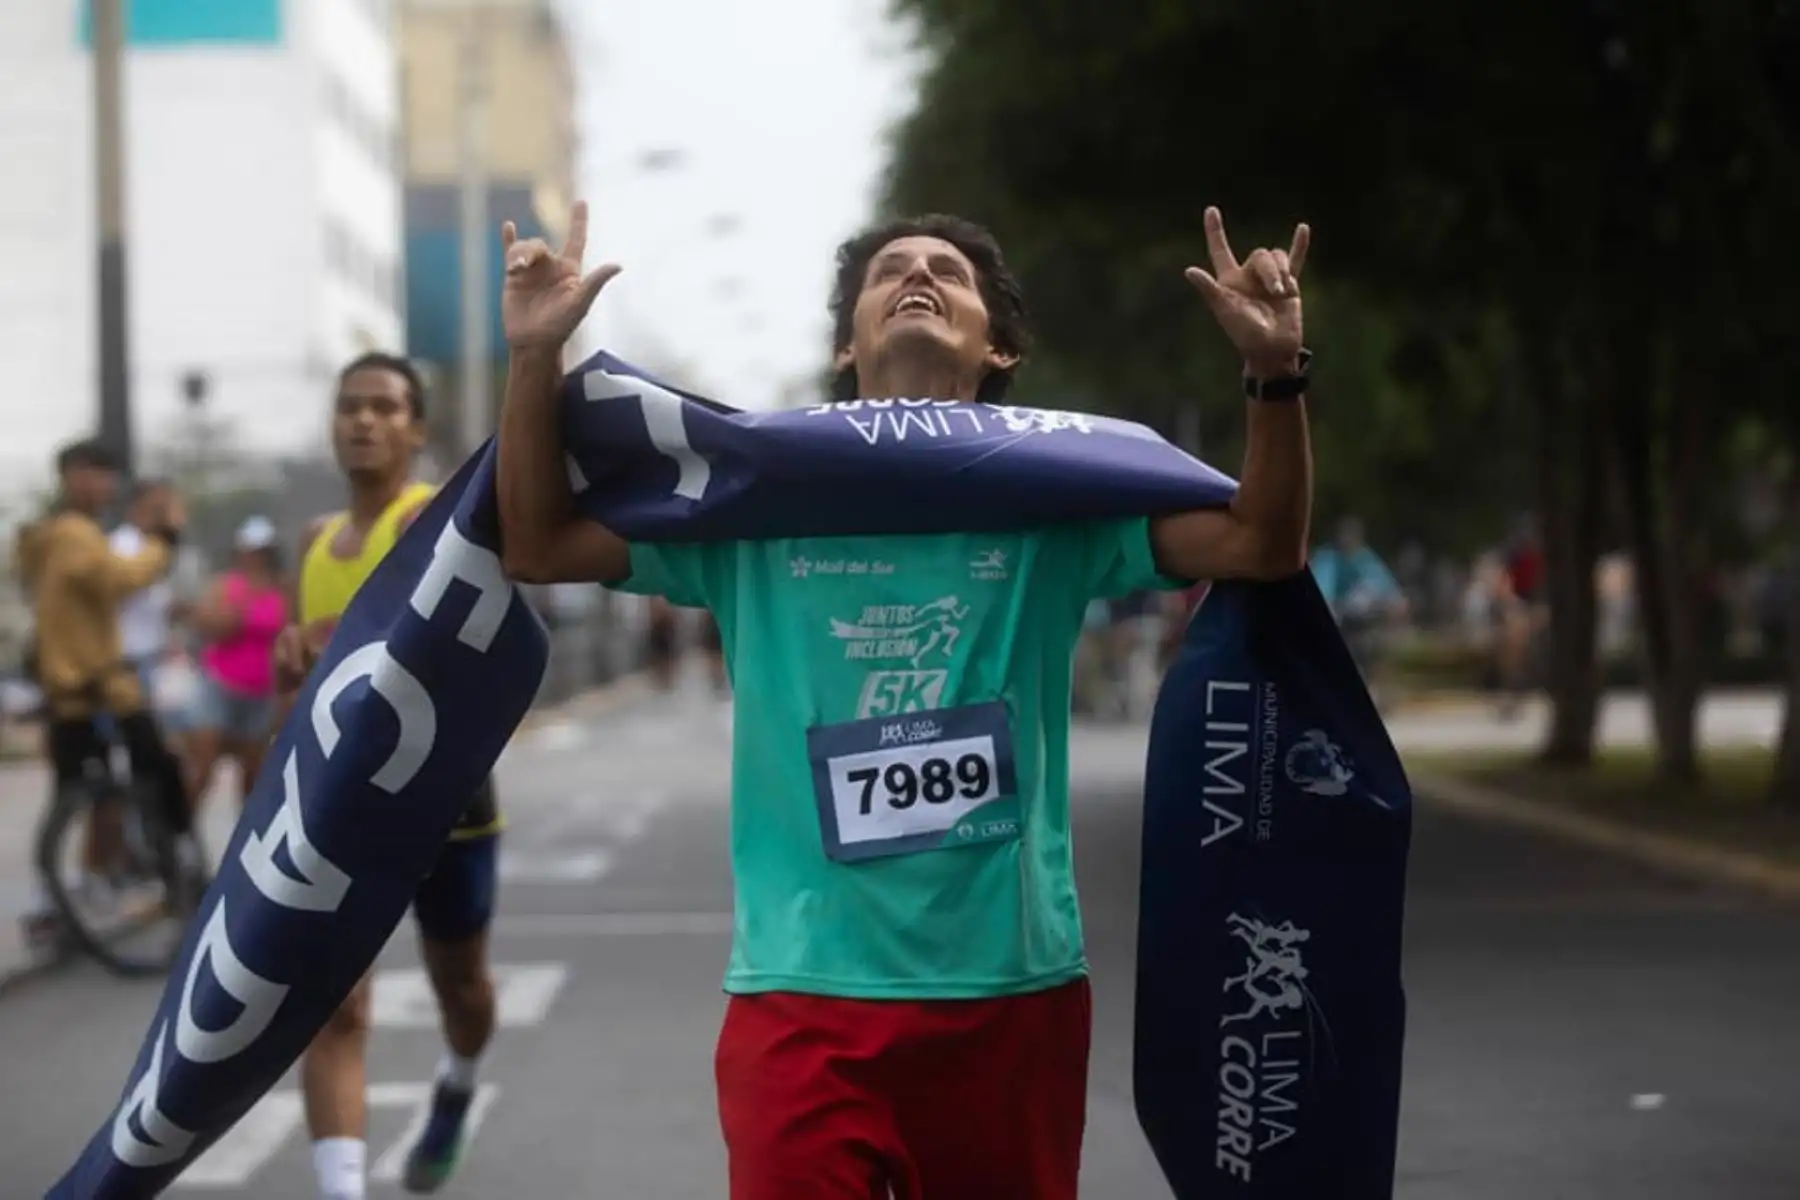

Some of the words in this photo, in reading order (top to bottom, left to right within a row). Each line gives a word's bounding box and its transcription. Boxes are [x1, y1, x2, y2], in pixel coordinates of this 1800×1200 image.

[845, 408, 984, 445] LIMA
[846, 560, 868, 573] del
[869, 560, 896, 574] Sur
[858, 604, 916, 626] JUNTOS
[867, 675, 941, 717] 5K
[1201, 681, 1250, 847] LIMA
[1258, 682, 1278, 815] MUNICIPALIDAD
[847, 753, 990, 815] 7989
[1256, 819, 1272, 841] DE
[1215, 1035, 1256, 1183] CORRE
[1257, 1031, 1301, 1151] LIMA
